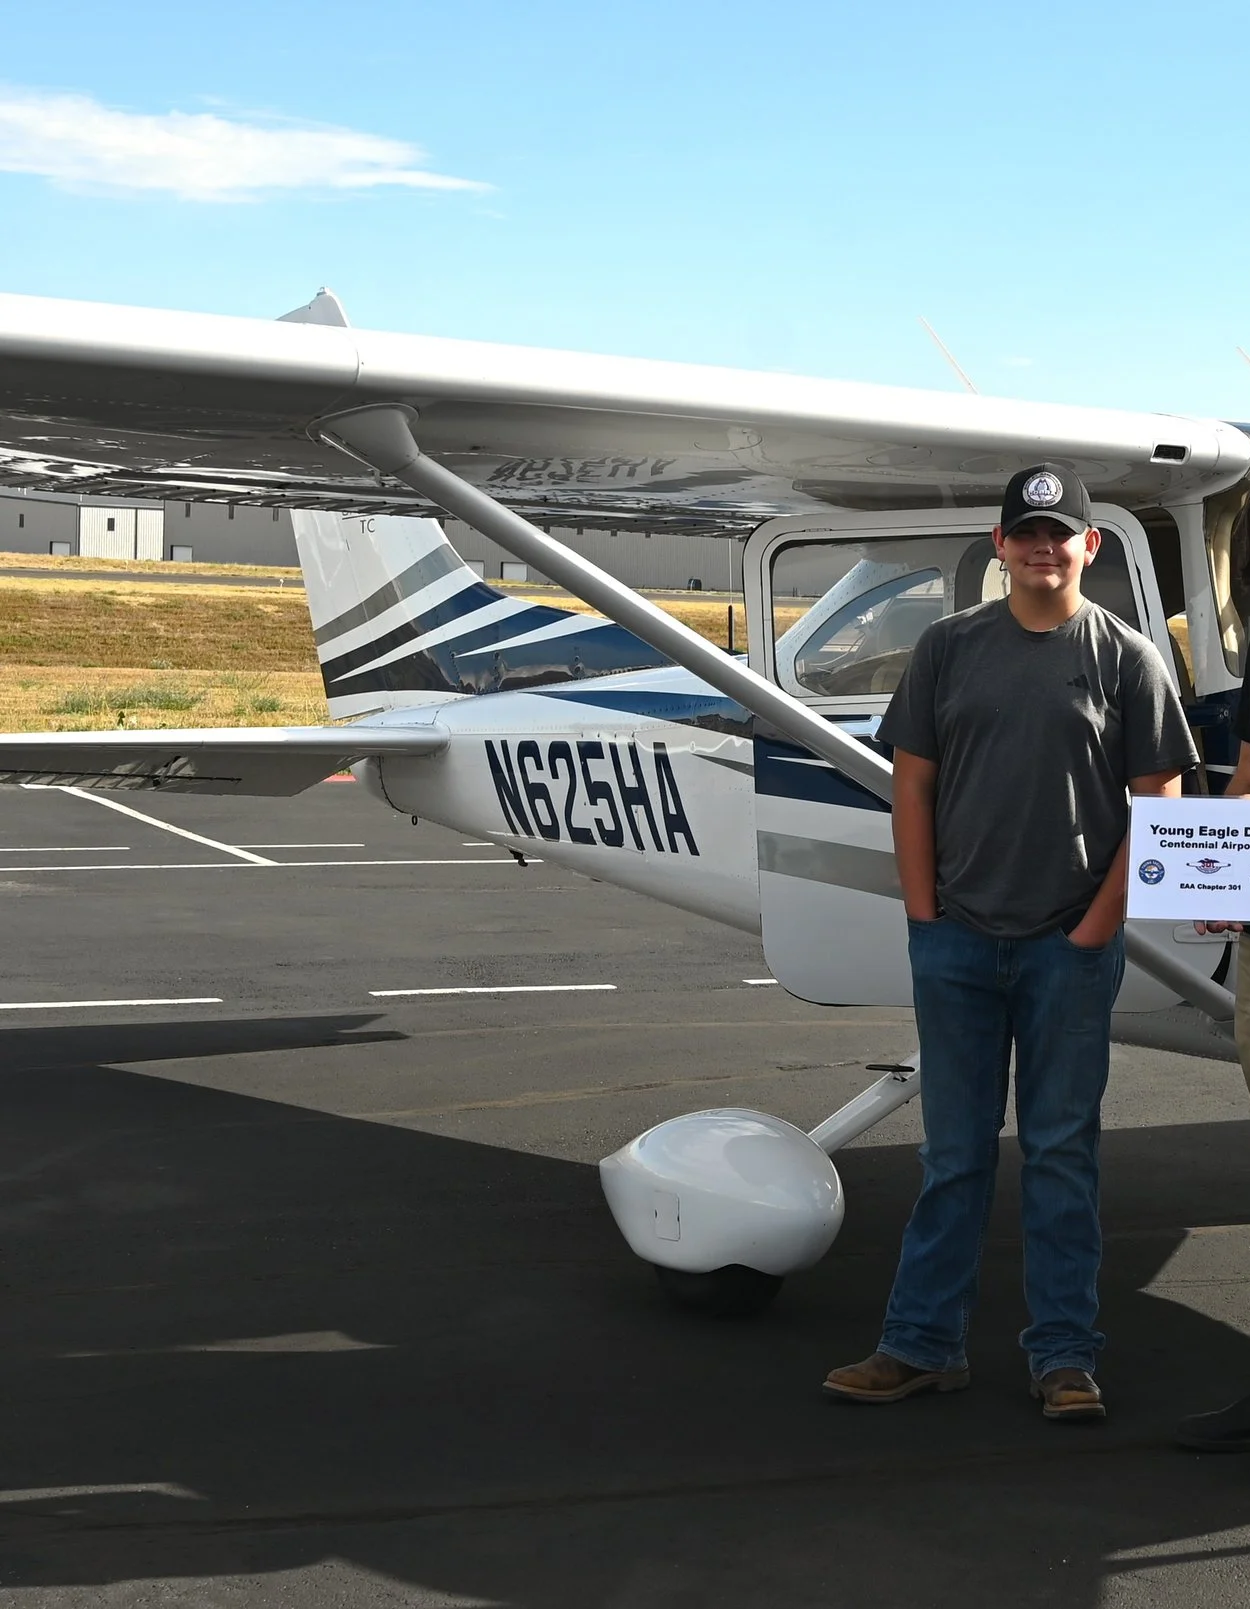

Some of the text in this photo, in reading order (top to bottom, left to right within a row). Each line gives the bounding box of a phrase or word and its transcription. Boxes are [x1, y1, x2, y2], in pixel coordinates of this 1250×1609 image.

[359, 518, 376, 534] TC
[484, 740, 701, 857] N625HA
[1150, 824, 1194, 839] Young
[1199, 826, 1239, 840] Eagle
[1159, 840, 1218, 850] Centennial
[1197, 883, 1227, 892] Chapter
